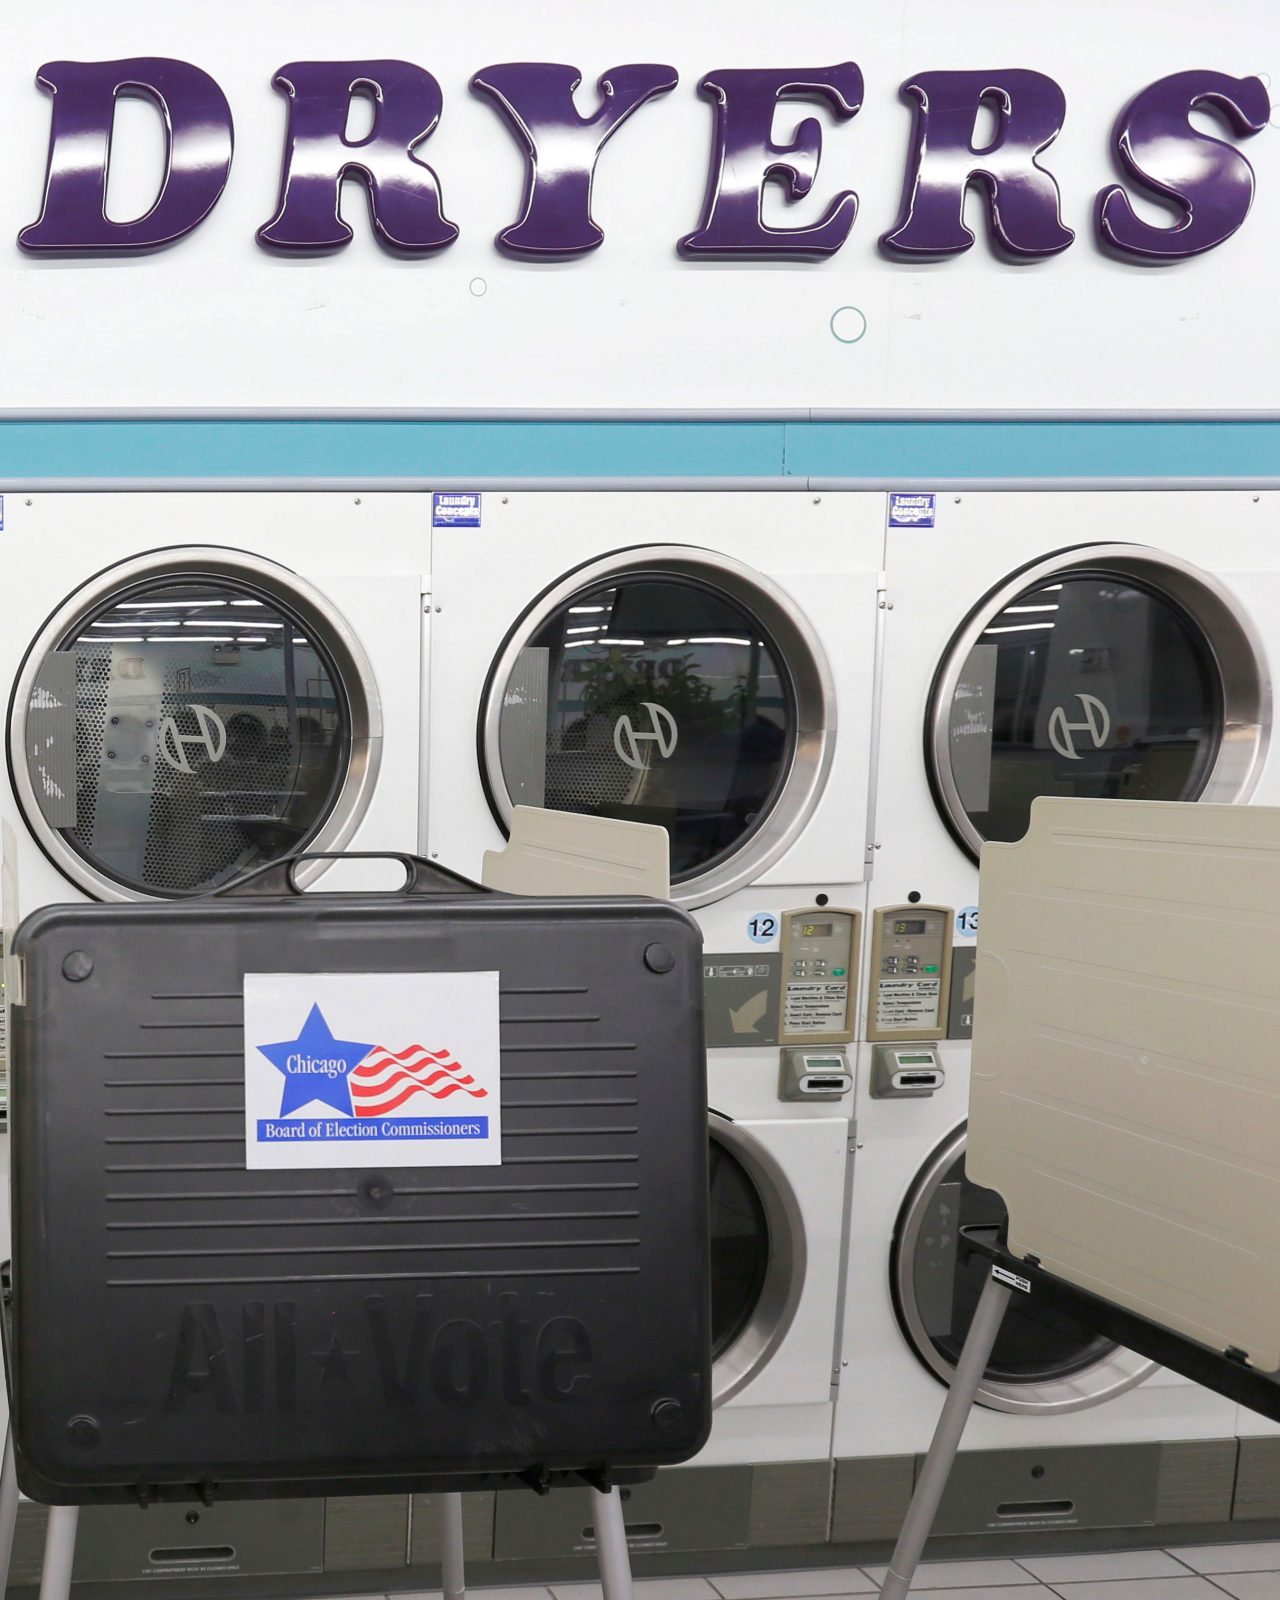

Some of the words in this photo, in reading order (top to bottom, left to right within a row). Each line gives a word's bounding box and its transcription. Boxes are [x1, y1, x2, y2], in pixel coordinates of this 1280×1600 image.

[17, 56, 1270, 266] DRYERS
[439, 495, 476, 507] Laundry
[749, 918, 774, 937] 12
[803, 924, 815, 936] 12
[958, 912, 978, 930] 13
[286, 1054, 347, 1078] Chicago
[265, 1123, 306, 1138] Board
[308, 1122, 323, 1137] of
[326, 1122, 378, 1137] Election
[381, 1121, 481, 1136] Commissioners
[365, 1291, 594, 1408] Vote
